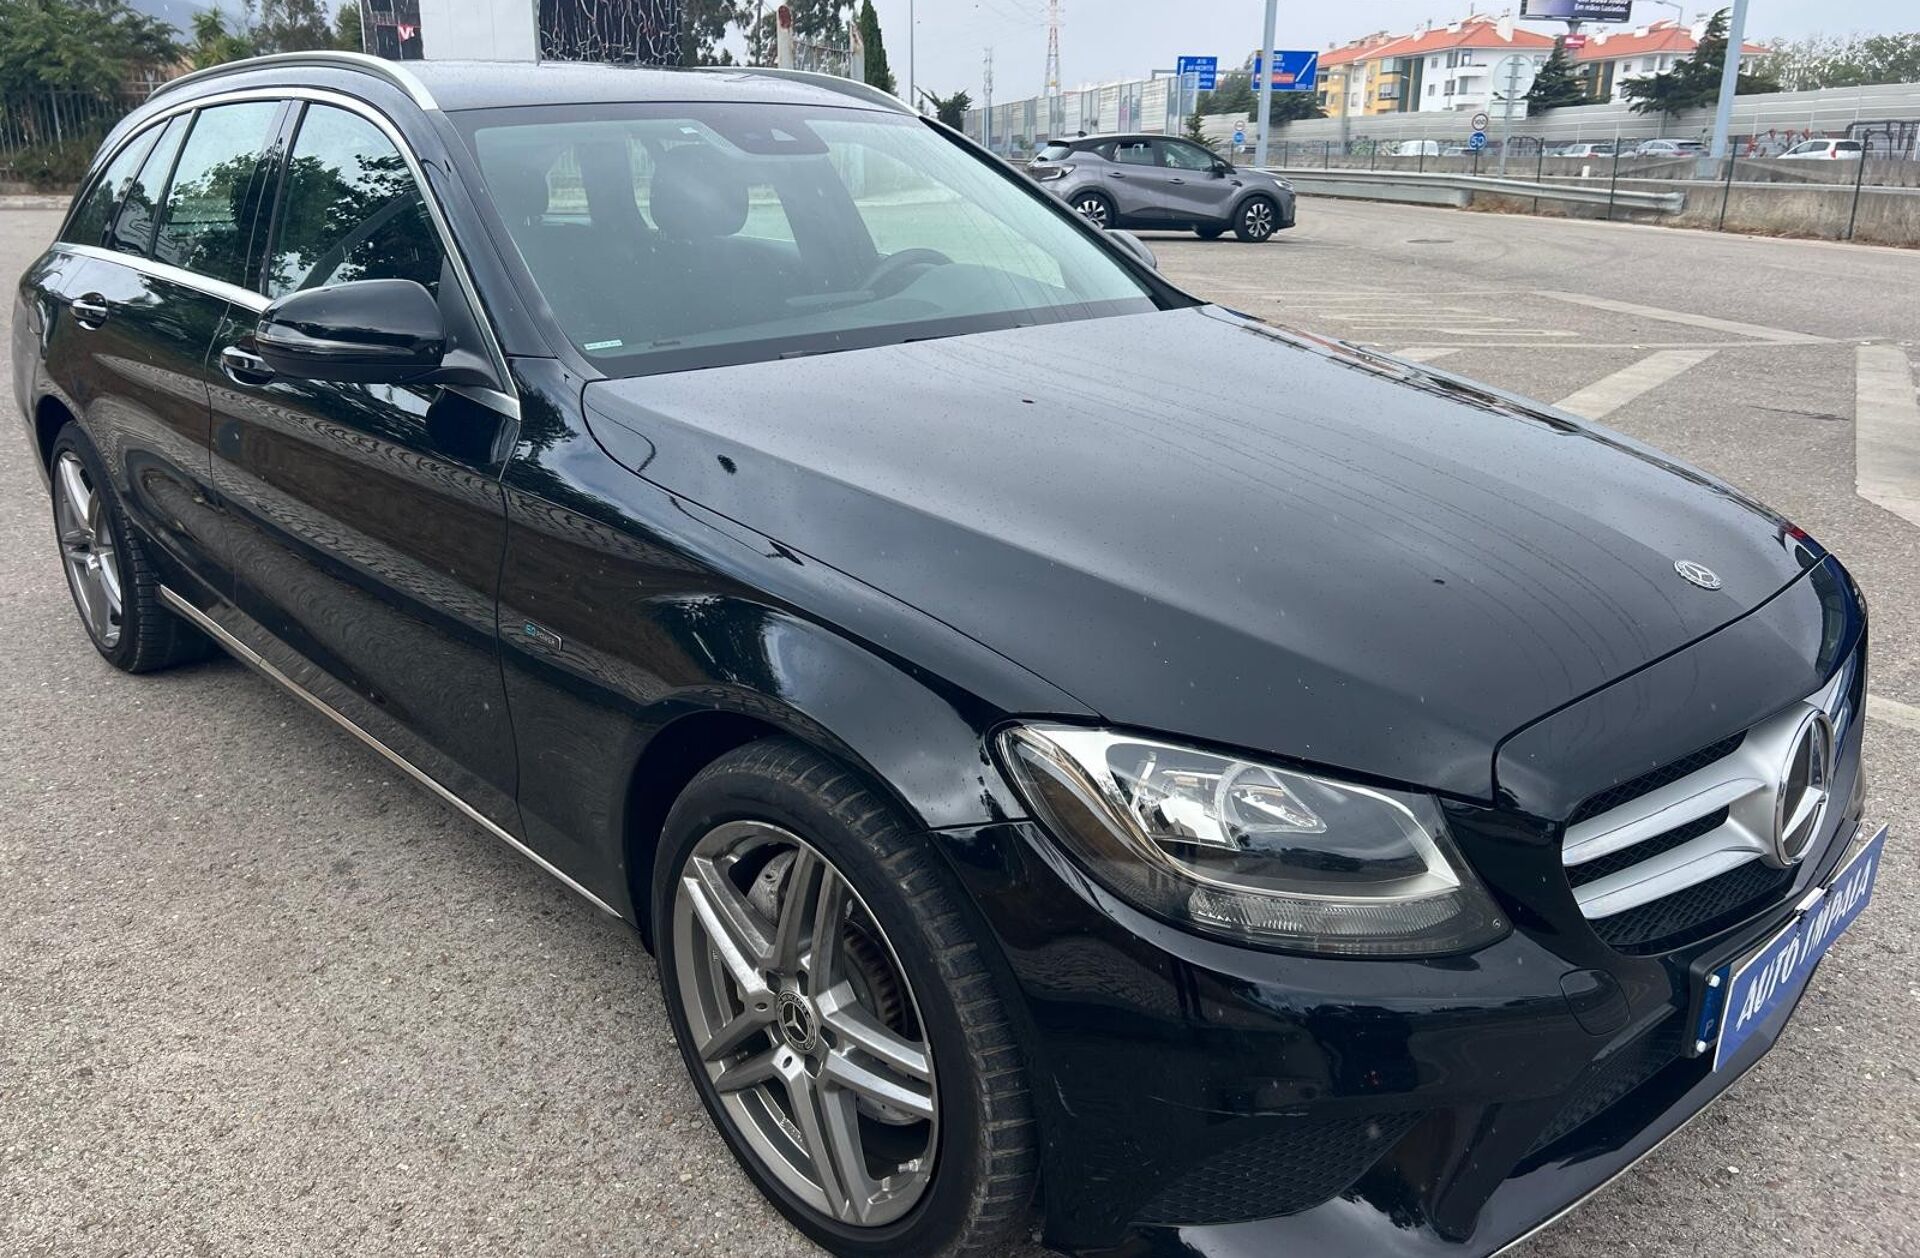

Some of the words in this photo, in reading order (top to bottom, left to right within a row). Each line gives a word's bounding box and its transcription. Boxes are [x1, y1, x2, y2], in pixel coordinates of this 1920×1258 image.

[1471, 136, 1484, 147] 50
[1736, 937, 1800, 1032] AUTO
[1799, 856, 1872, 966] IMPALA
